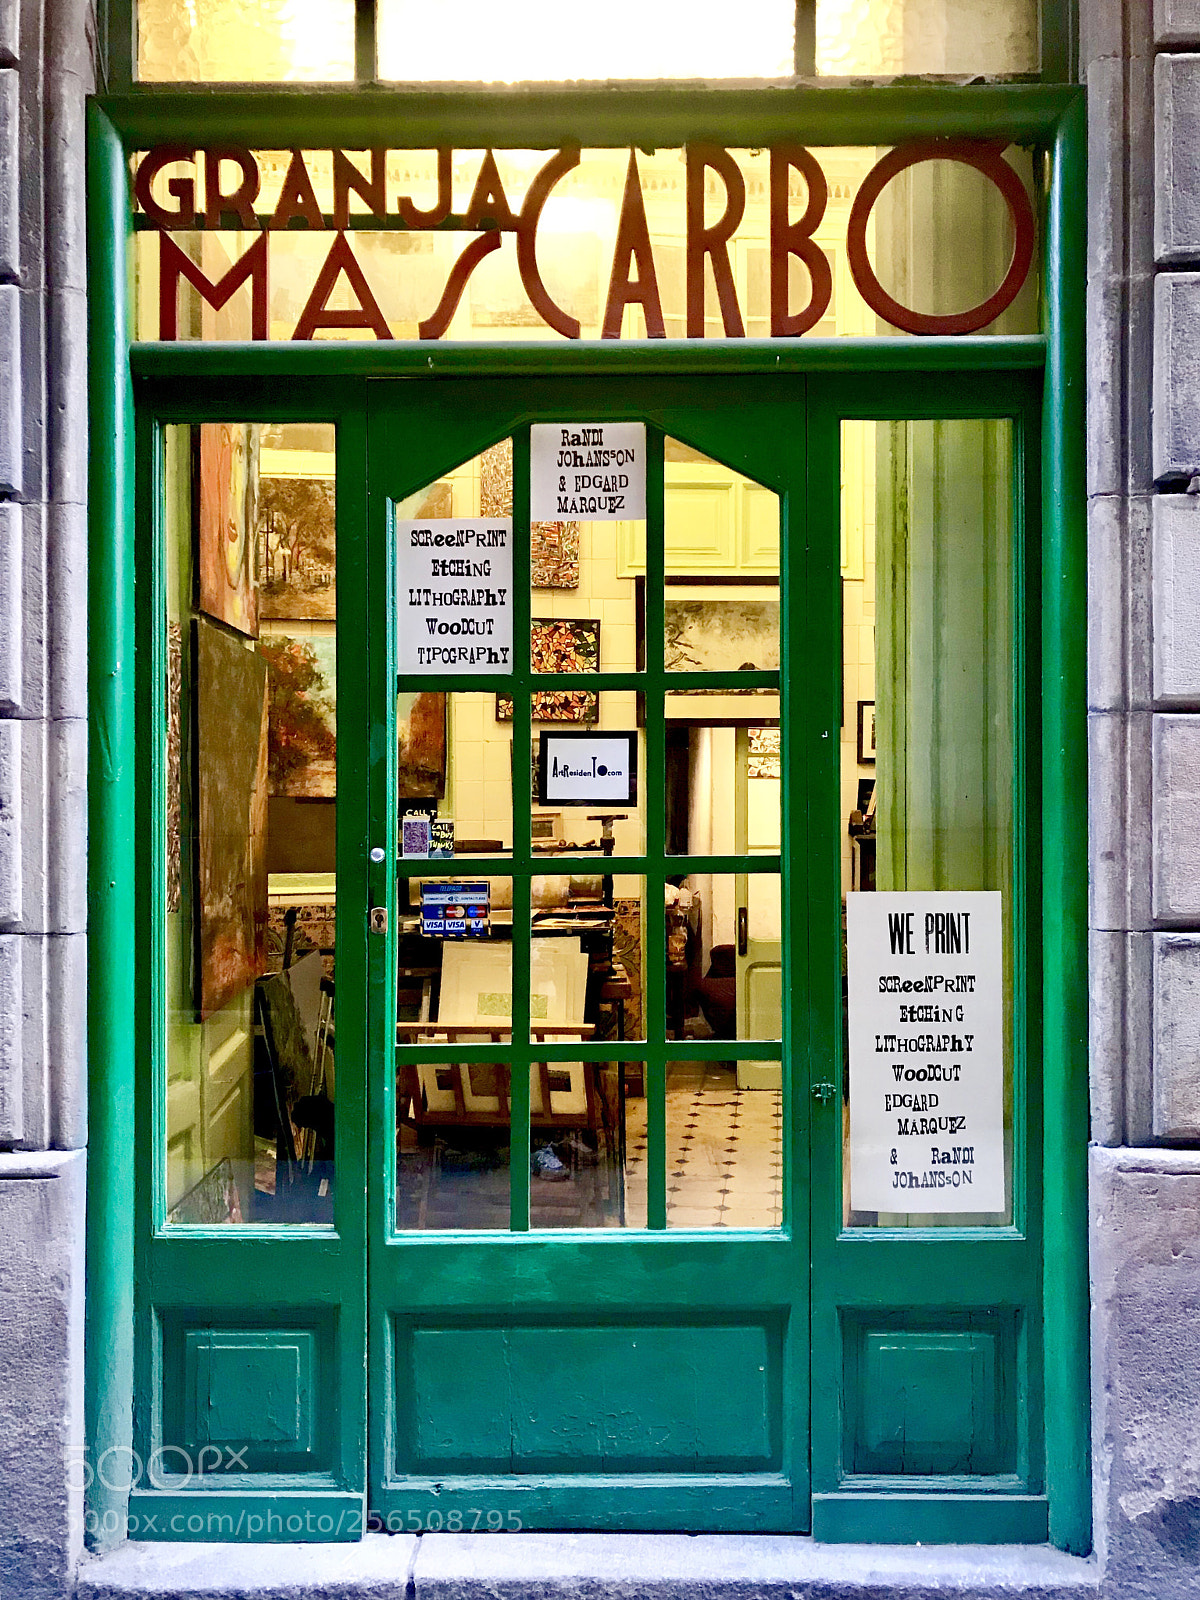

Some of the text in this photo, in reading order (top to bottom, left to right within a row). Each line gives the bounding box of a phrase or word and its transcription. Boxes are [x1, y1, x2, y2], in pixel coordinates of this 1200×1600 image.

[136, 145, 512, 229] GRANJA
[559, 475, 628, 492] & EDGARD
[426, 921, 443, 929] VISA
[447, 921, 465, 929] VISA
[888, 913, 970, 955] WE PRINT
[885, 1094, 939, 1112] EDGARD
[890, 1148, 898, 1165] &
